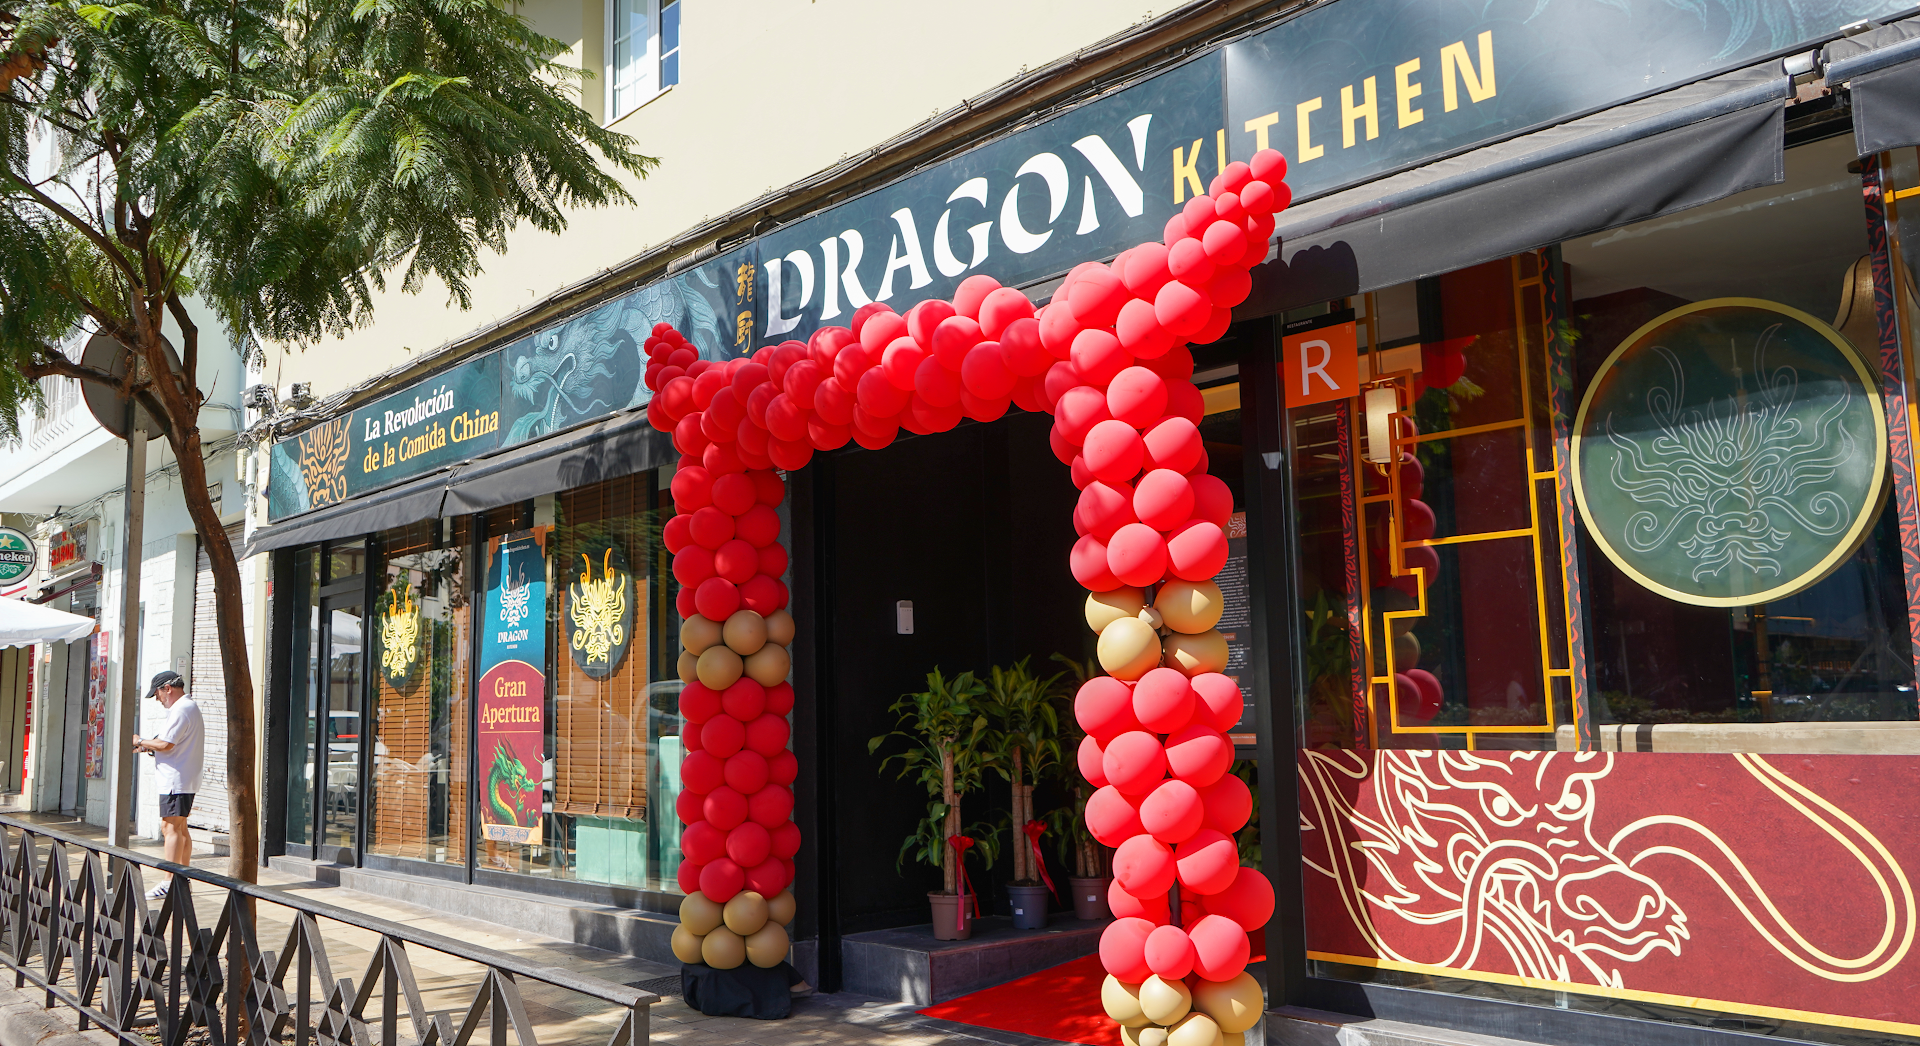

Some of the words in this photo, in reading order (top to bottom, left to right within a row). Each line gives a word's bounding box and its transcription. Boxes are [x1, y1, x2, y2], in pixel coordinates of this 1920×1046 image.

[763, 114, 1153, 339] DRAGON
[1173, 30, 1497, 205] KITCHEN
[1300, 339, 1340, 396] R
[363, 417, 381, 442] La
[383, 384, 454, 436] Revolución
[363, 446, 380, 473] de
[382, 441, 396, 468] la
[399, 421, 446, 462] Comida
[450, 409, 499, 443] China
[0, 551, 31, 562] neken
[497, 629, 529, 643] DRAGON
[494, 676, 527, 698] Gran
[481, 702, 540, 730] Apertura
